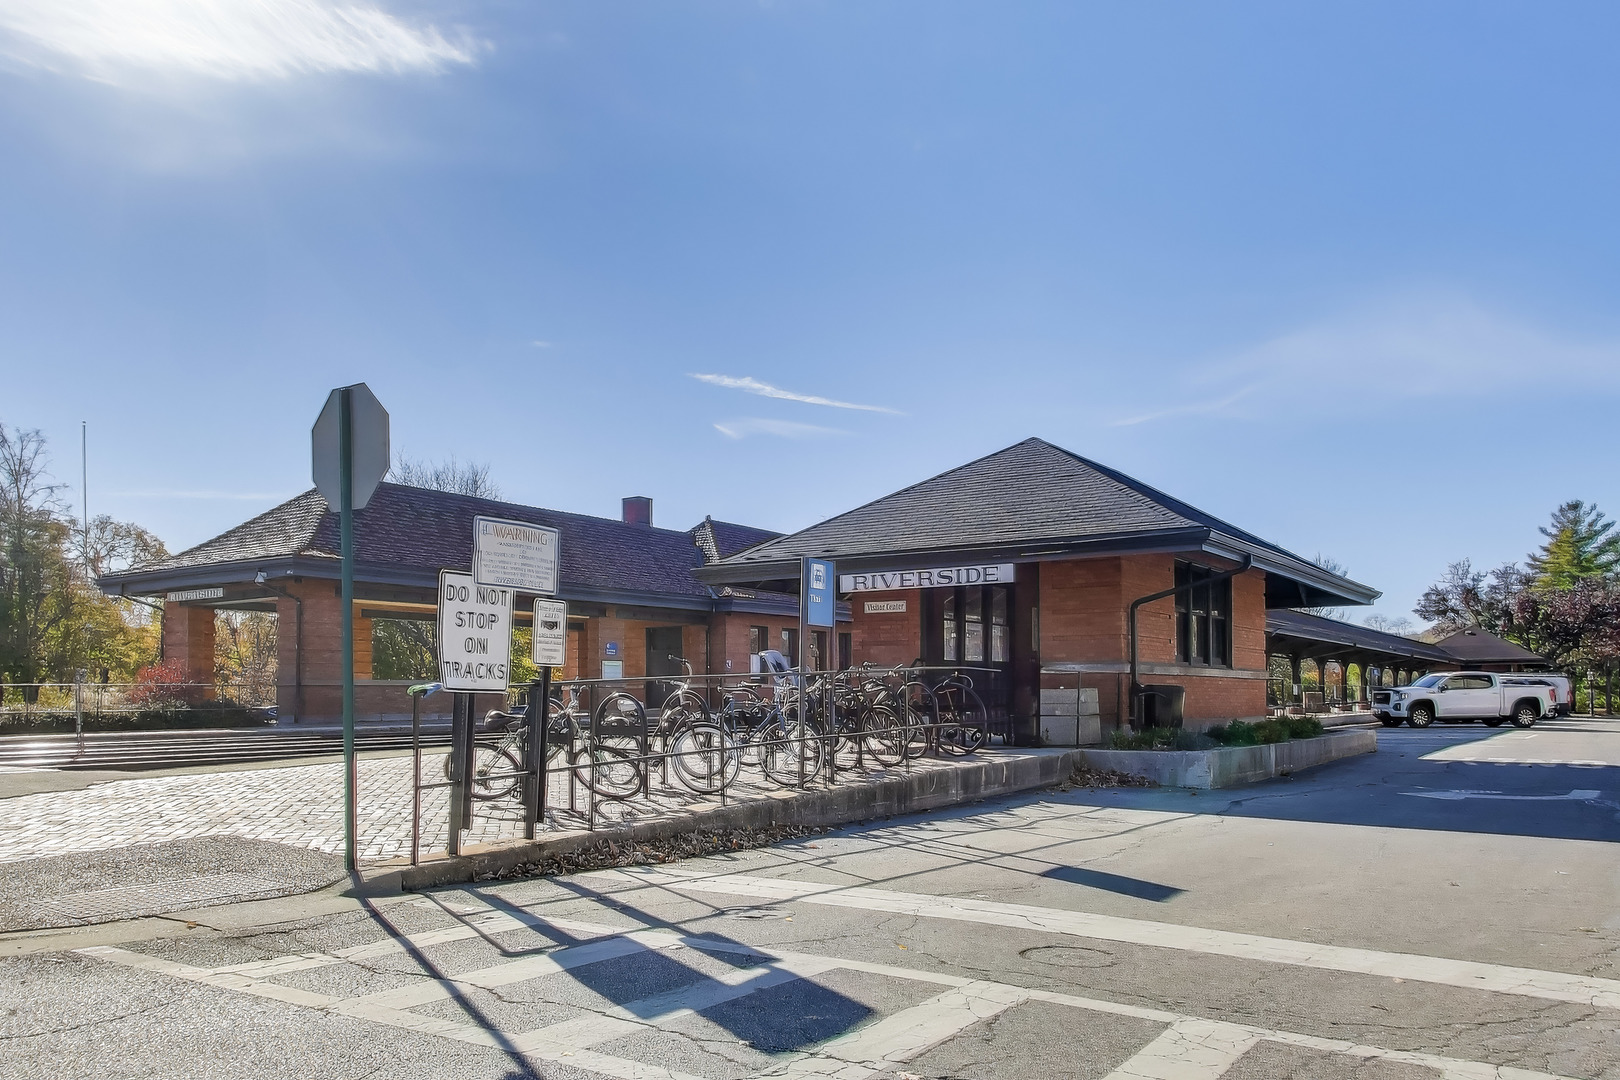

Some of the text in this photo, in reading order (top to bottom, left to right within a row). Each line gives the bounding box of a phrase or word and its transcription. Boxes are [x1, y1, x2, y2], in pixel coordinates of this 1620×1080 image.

[492, 525, 548, 546] WARNING
[852, 566, 999, 591] RIVERSIDE
[446, 584, 509, 606] DO NOT
[886, 601, 905, 611] Center
[455, 611, 500, 630] STOP
[464, 637, 489, 655] ON
[444, 661, 506, 680] TRACKS
